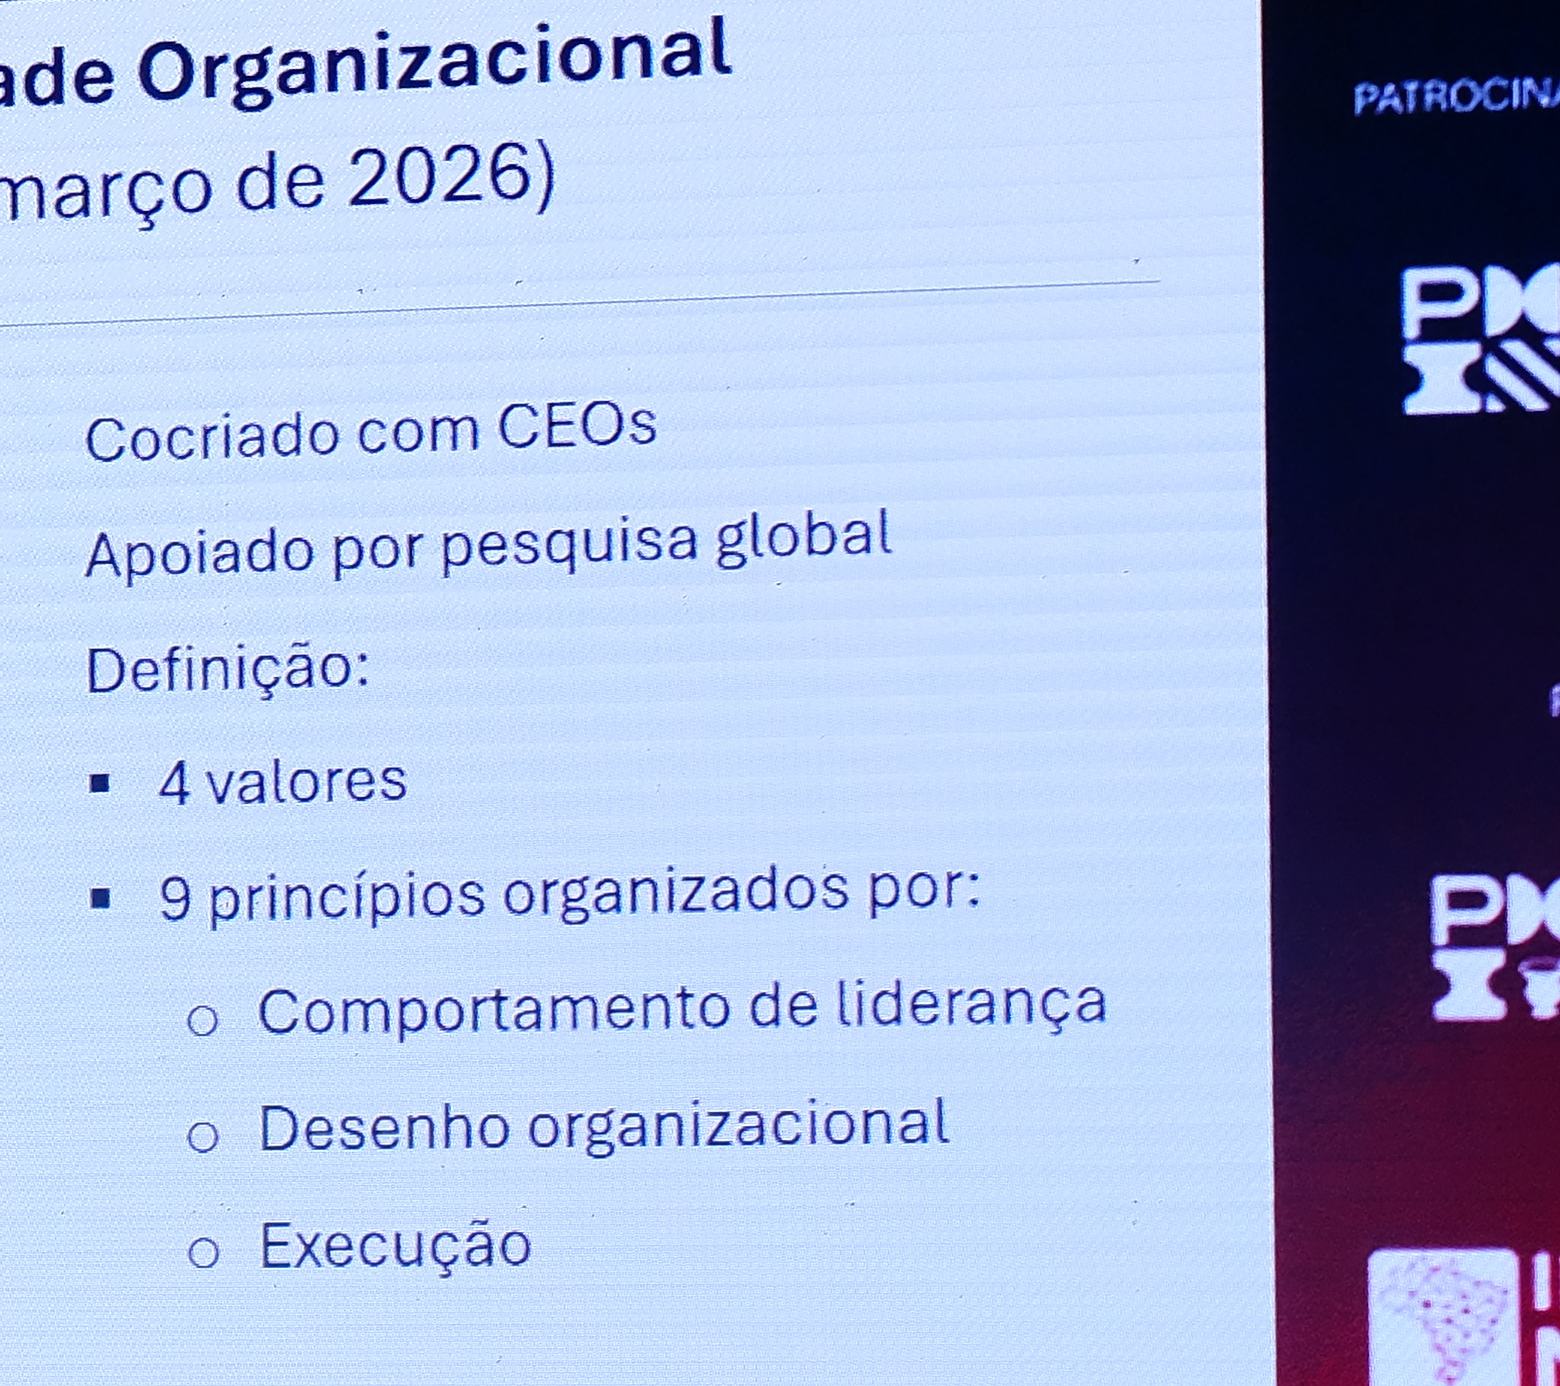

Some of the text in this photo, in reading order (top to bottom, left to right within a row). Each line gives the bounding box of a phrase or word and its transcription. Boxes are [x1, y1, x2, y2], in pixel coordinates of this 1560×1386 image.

[139, 15, 732, 112] Organizacional
[238, 151, 323, 211] de
[350, 139, 553, 214] 2026)
[87, 401, 656, 462] Cocriado com CEOs
[85, 508, 891, 587] Apoiado por pesquisa global
[89, 642, 367, 701] Definição:
[159, 759, 406, 805] 4 valores
[162, 865, 978, 931] 9 princípios organizados por:
[260, 979, 1107, 1043] Comportamento de liderança
[262, 1097, 949, 1159] Desenho organizacional
[263, 1219, 530, 1278] Execução
